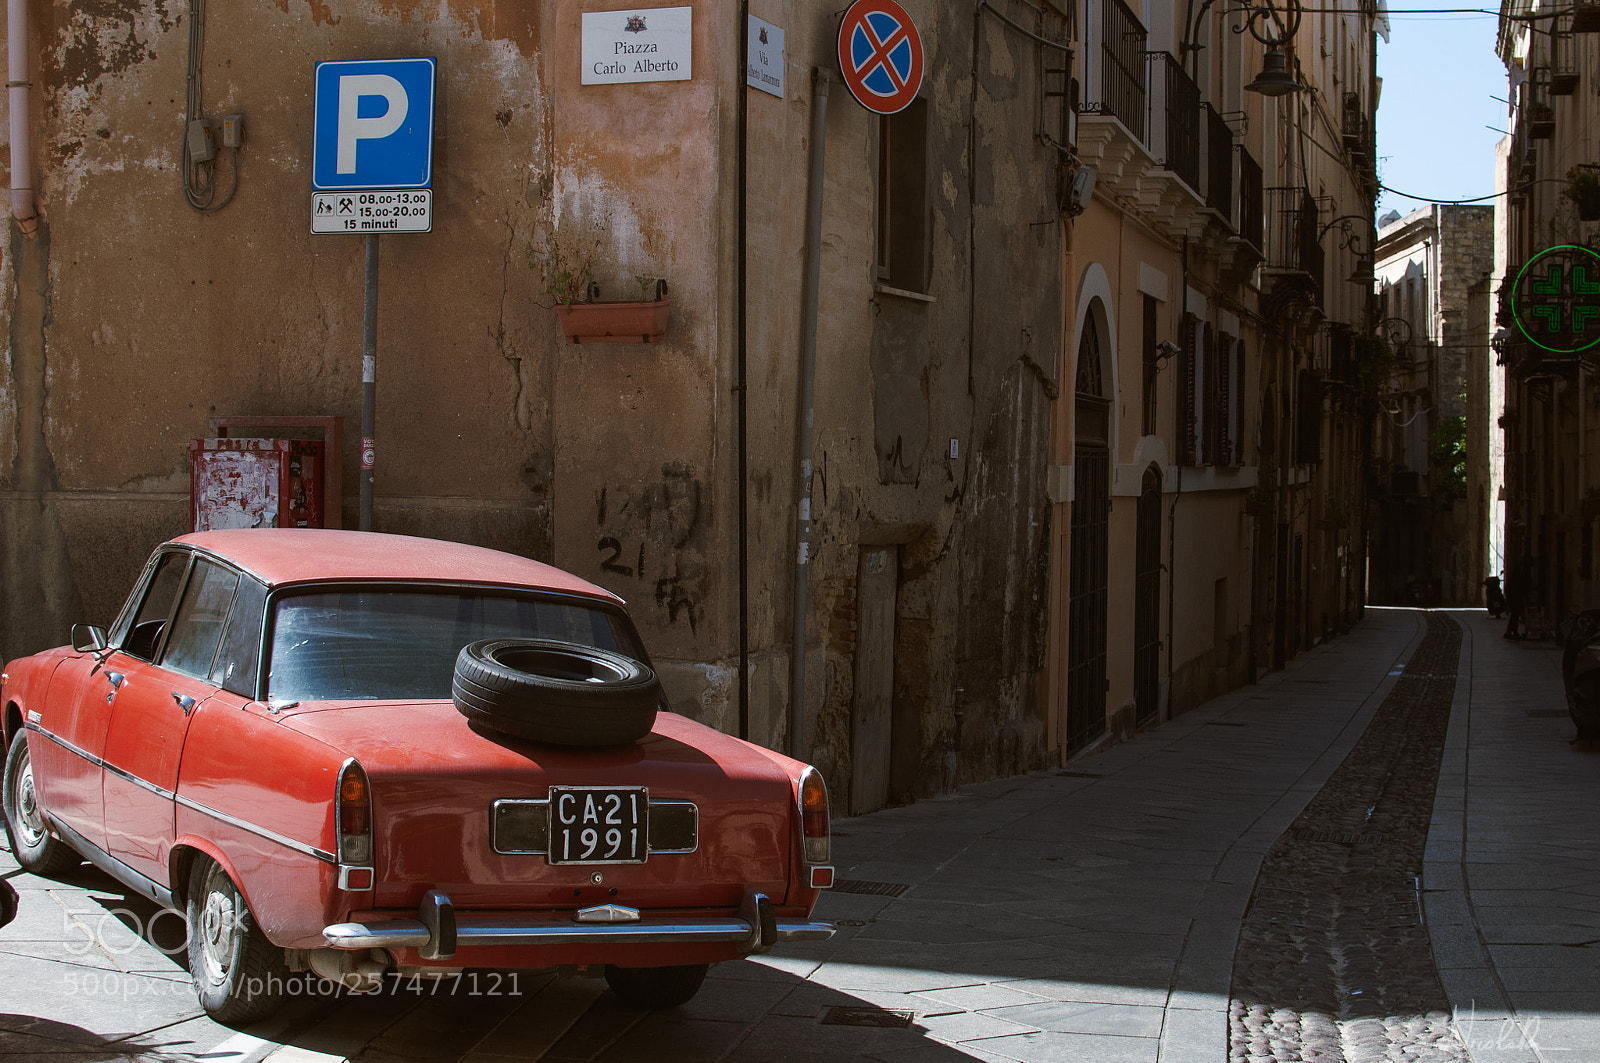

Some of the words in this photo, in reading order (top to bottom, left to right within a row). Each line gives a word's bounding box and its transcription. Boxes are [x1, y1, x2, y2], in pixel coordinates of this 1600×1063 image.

[614, 41, 658, 54] Piazza
[759, 50, 769, 66] Via
[593, 61, 627, 75] Carlo
[633, 59, 679, 73] Alberto
[336, 74, 409, 174] P
[359, 193, 426, 205] 08.00-13.00
[359, 206, 426, 218] 15.00-20.00
[344, 219, 357, 229] 15
[361, 218, 398, 229] minuti
[562, 827, 637, 860] 1991
